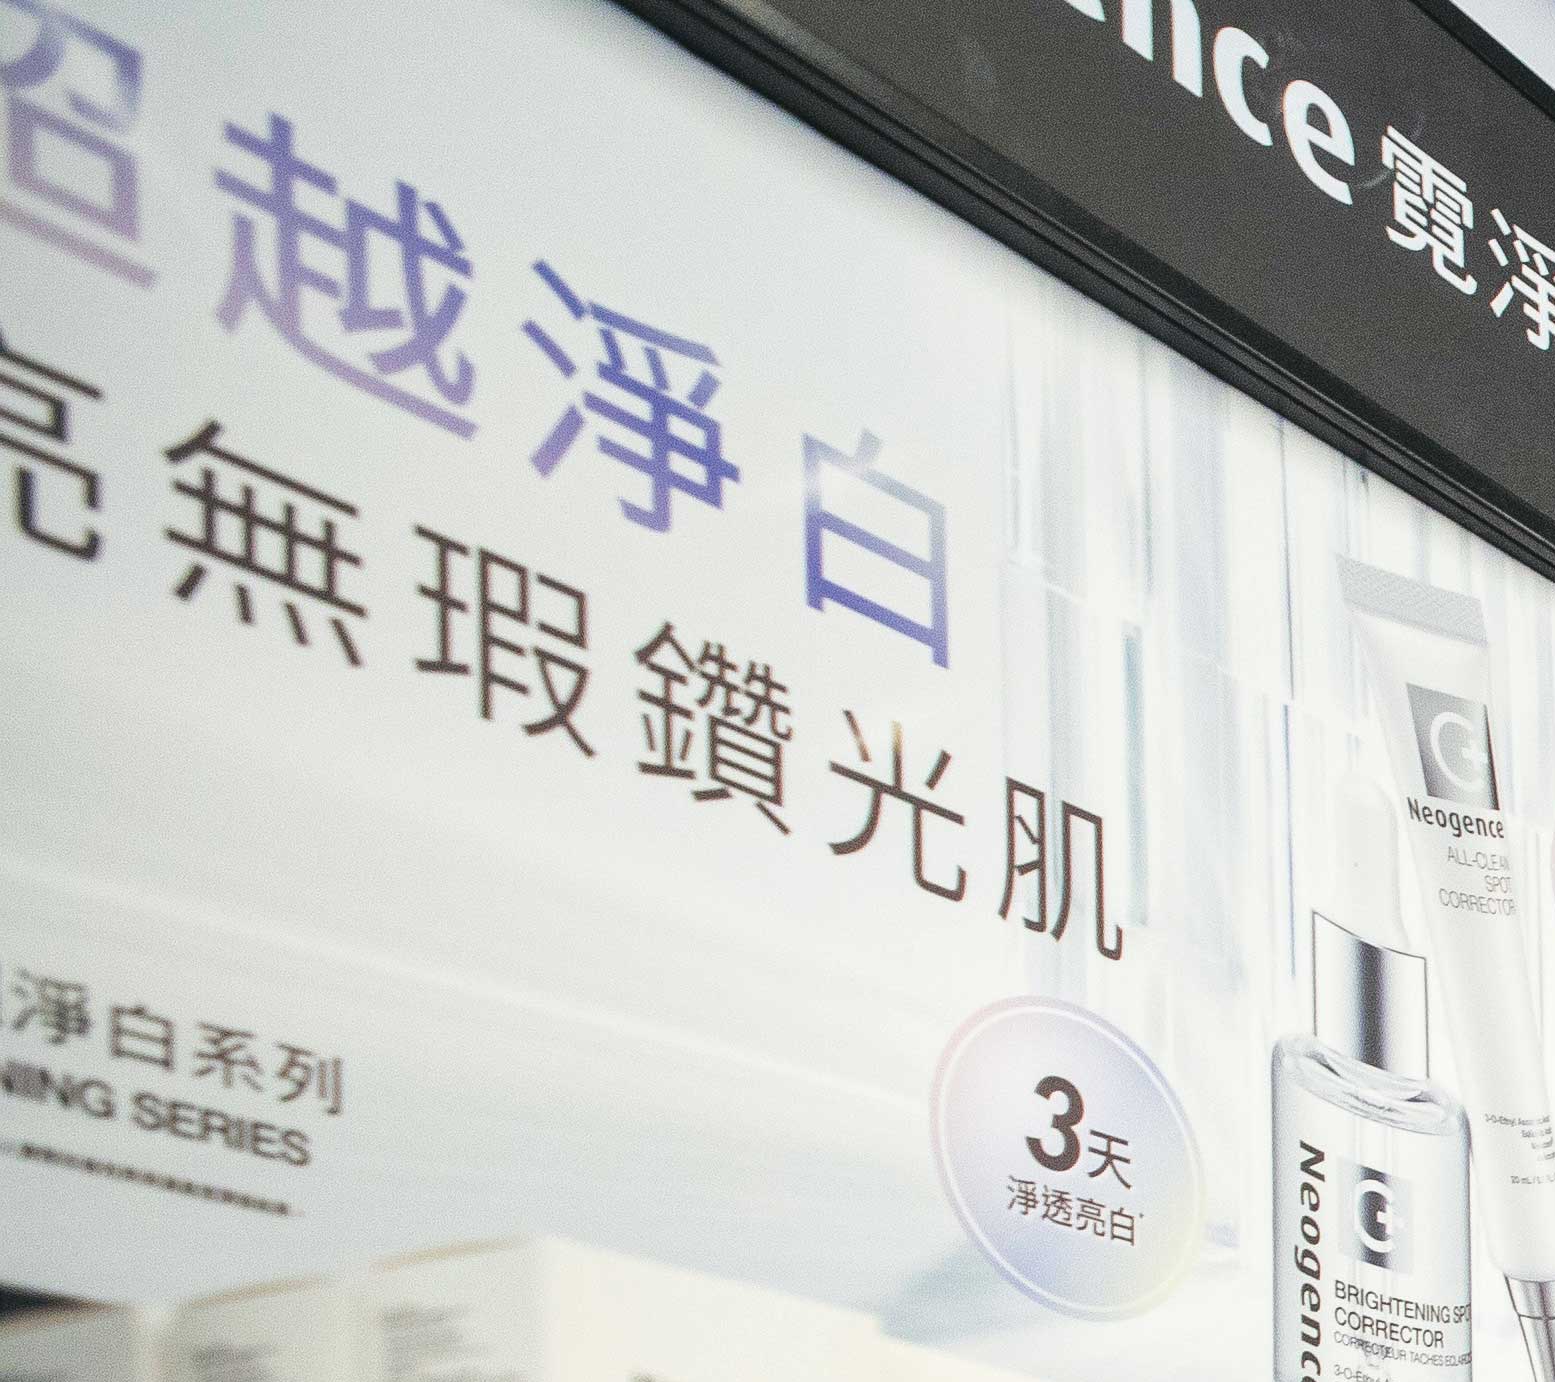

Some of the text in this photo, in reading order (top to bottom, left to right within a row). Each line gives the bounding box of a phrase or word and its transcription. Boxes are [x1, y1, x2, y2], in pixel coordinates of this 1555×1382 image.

[1407, 796, 1505, 839] Neogence
[0, 966, 346, 1116] 淨白系列
[131, 1091, 311, 1168] SERIES
[1026, 1075, 1133, 1189] 3天
[1335, 1280, 1451, 1325] BRIGHTENING
[1335, 1307, 1445, 1349] CORRECTOR
